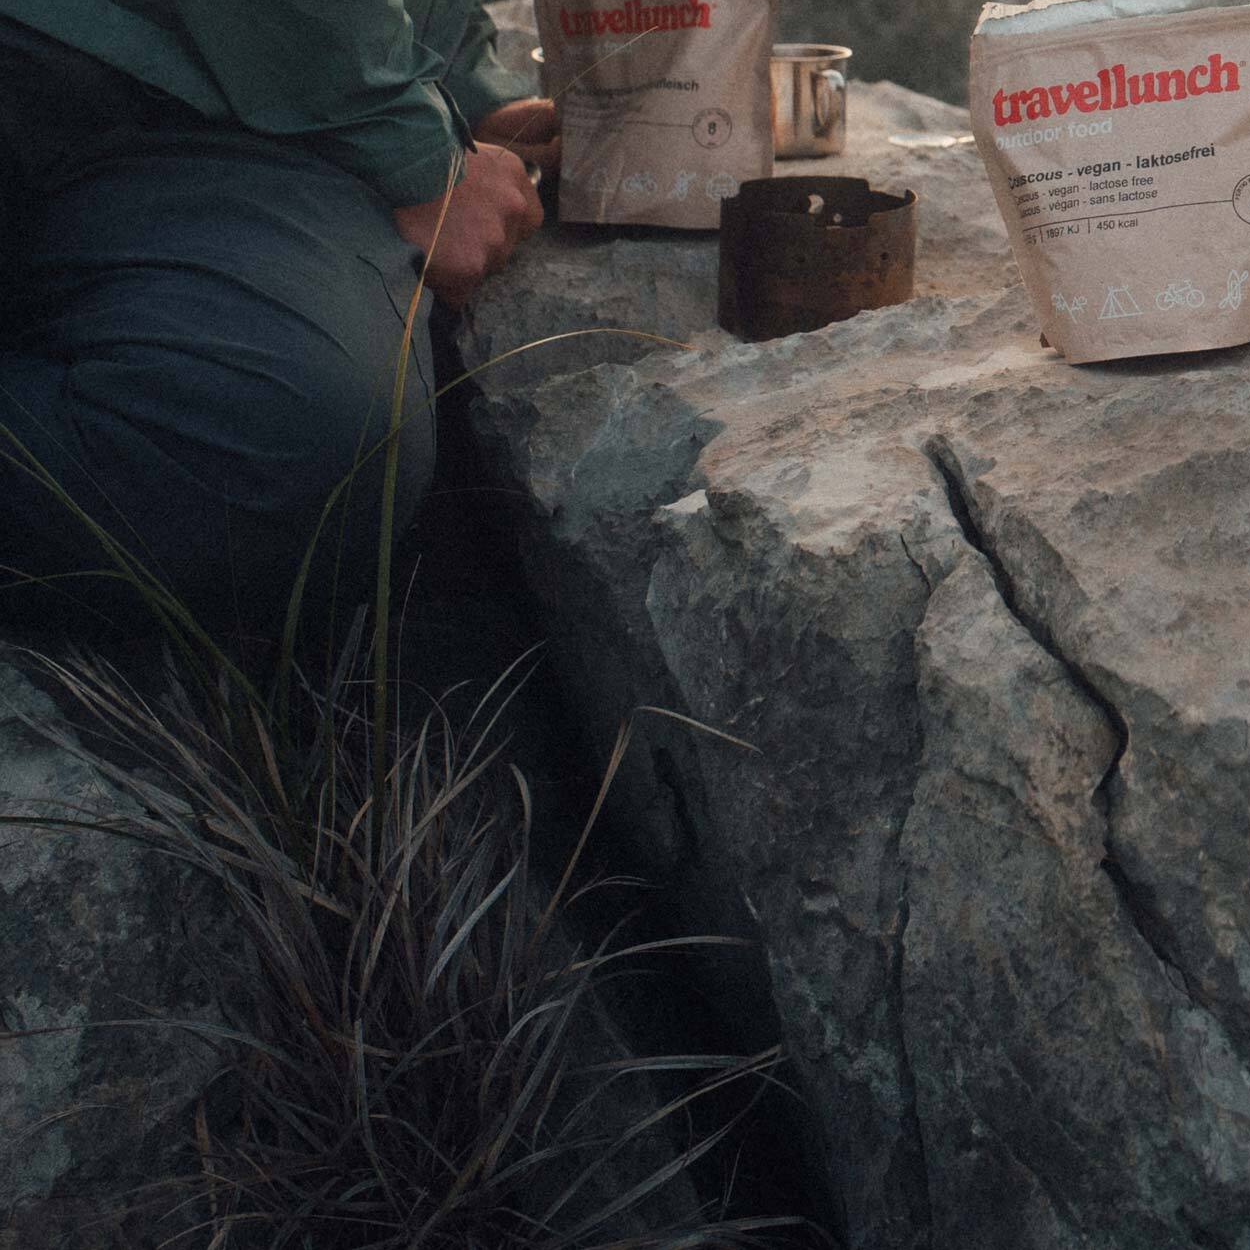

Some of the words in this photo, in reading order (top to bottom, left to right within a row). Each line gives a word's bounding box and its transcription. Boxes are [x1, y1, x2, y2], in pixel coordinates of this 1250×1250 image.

[992, 53, 1240, 127] travellunch
[995, 126, 1062, 150] outdoor
[1067, 117, 1113, 139] food
[1077, 161, 1121, 177] vegan
[1136, 143, 1216, 169] laktosefrei
[1048, 185, 1080, 199] vegan
[1089, 177, 1128, 191] lactose
[1131, 175, 1154, 187] free
[1048, 198, 1080, 213] végan
[1089, 194, 1115, 206] sans
[1118, 188, 1158, 202] lactose
[1067, 224, 1080, 235] KJ
[1096, 220, 1115, 231] 450
[1118, 218, 1138, 229] kcal
